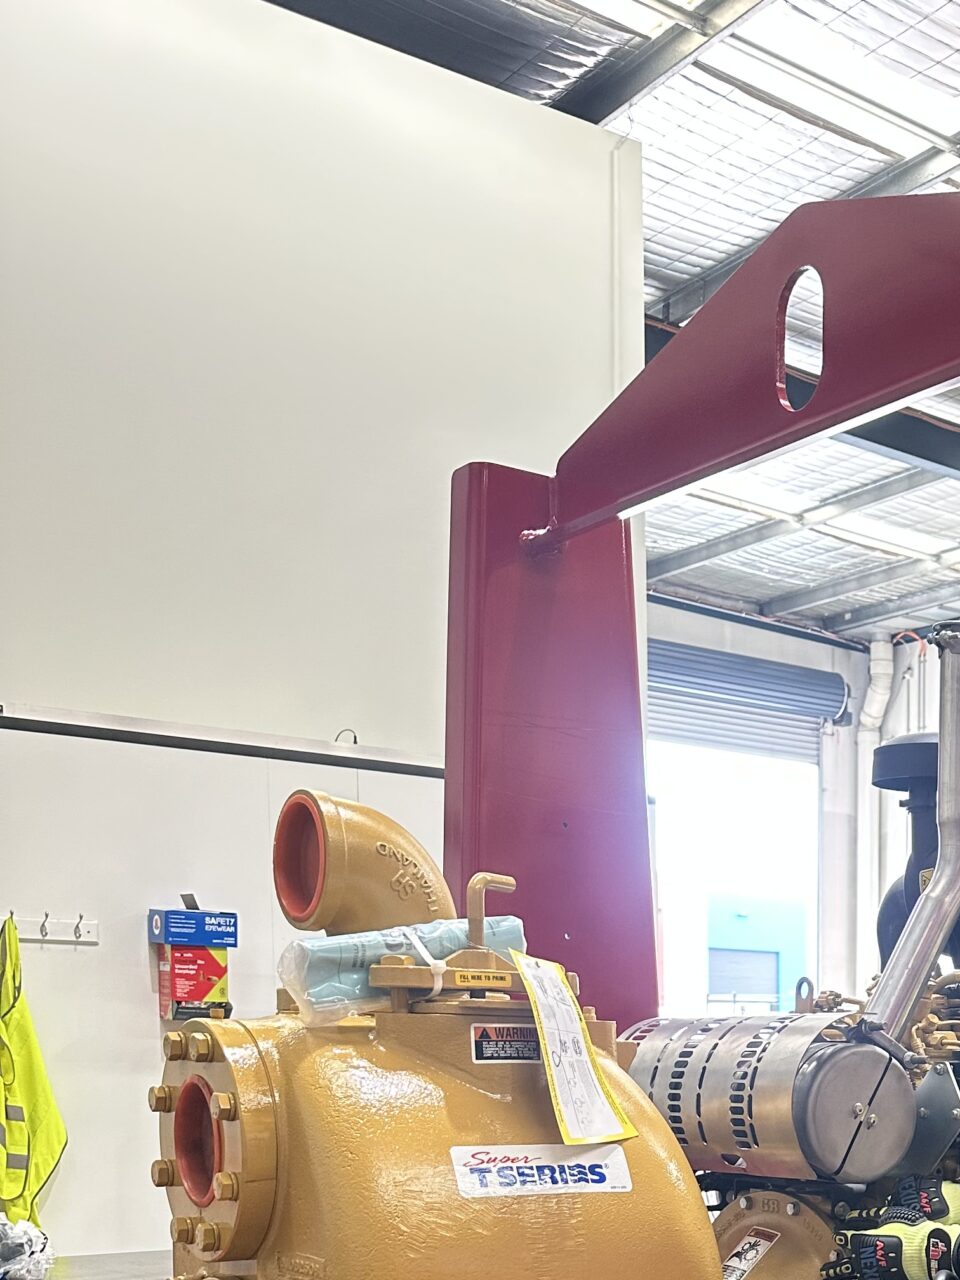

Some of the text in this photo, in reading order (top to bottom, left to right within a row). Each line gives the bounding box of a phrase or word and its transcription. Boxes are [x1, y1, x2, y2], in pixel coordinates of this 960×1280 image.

[205, 916, 235, 925] SAFETY
[495, 1027, 538, 1039] WARNIN
[463, 1151, 542, 1168] Super
